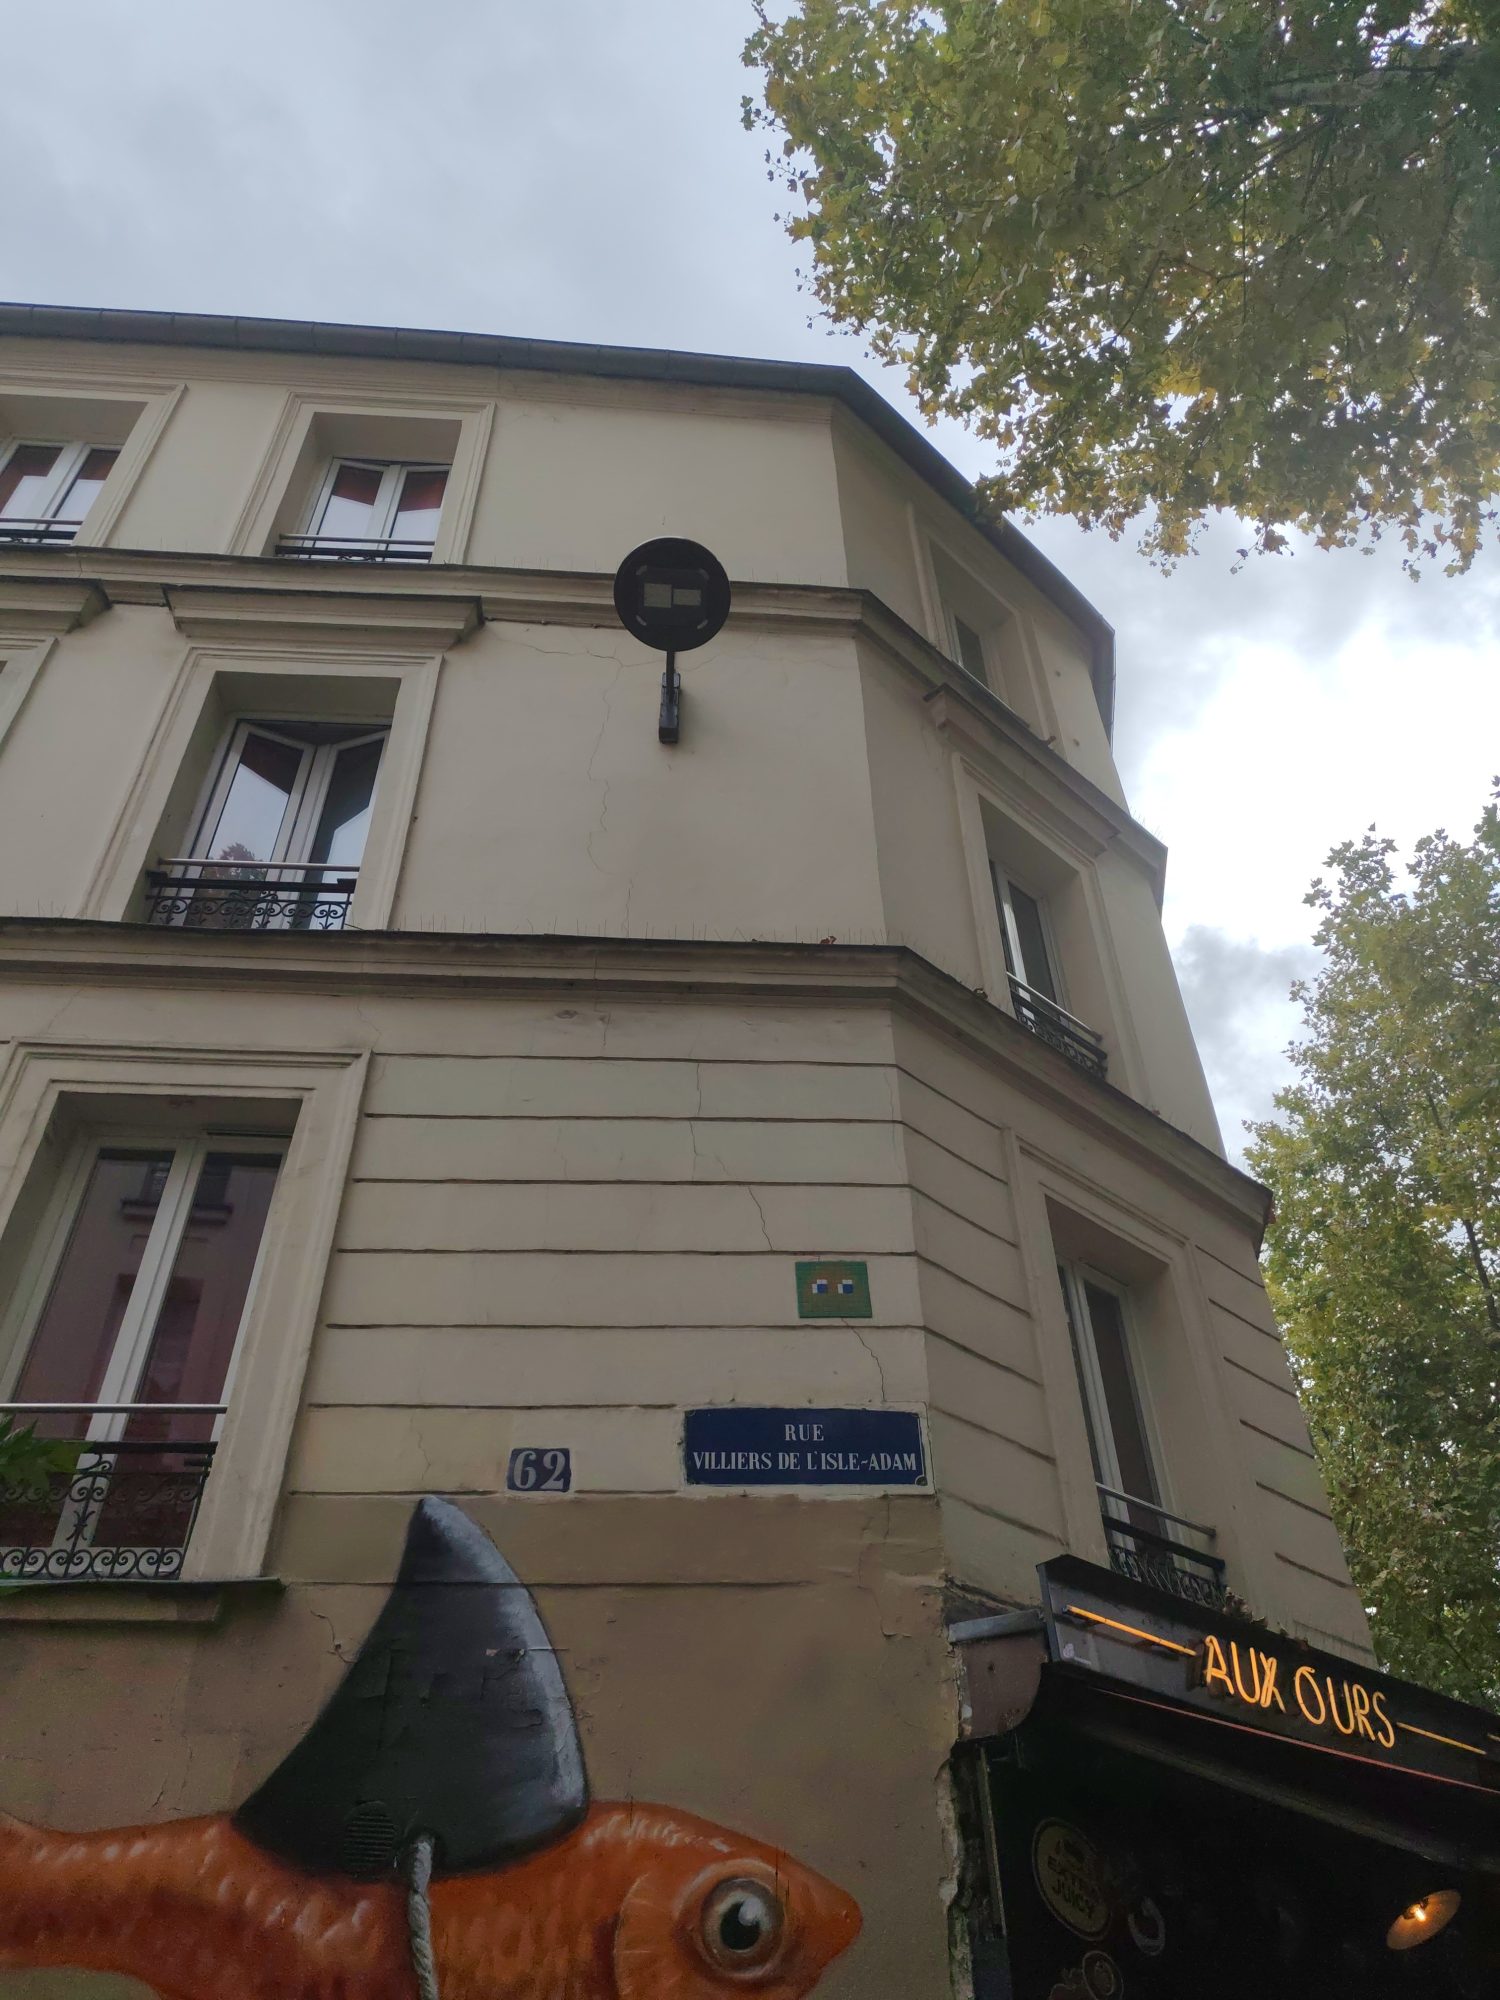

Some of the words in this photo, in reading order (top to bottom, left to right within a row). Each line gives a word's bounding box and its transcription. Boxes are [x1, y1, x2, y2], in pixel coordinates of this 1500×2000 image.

[785, 1424, 825, 1441] RUE
[513, 1450, 566, 1489] 62
[693, 1451, 773, 1470] VILLIERS
[778, 1452, 800, 1470] DE
[1204, 1635, 1287, 1714] AUX
[1294, 1665, 1395, 1748] OURS
